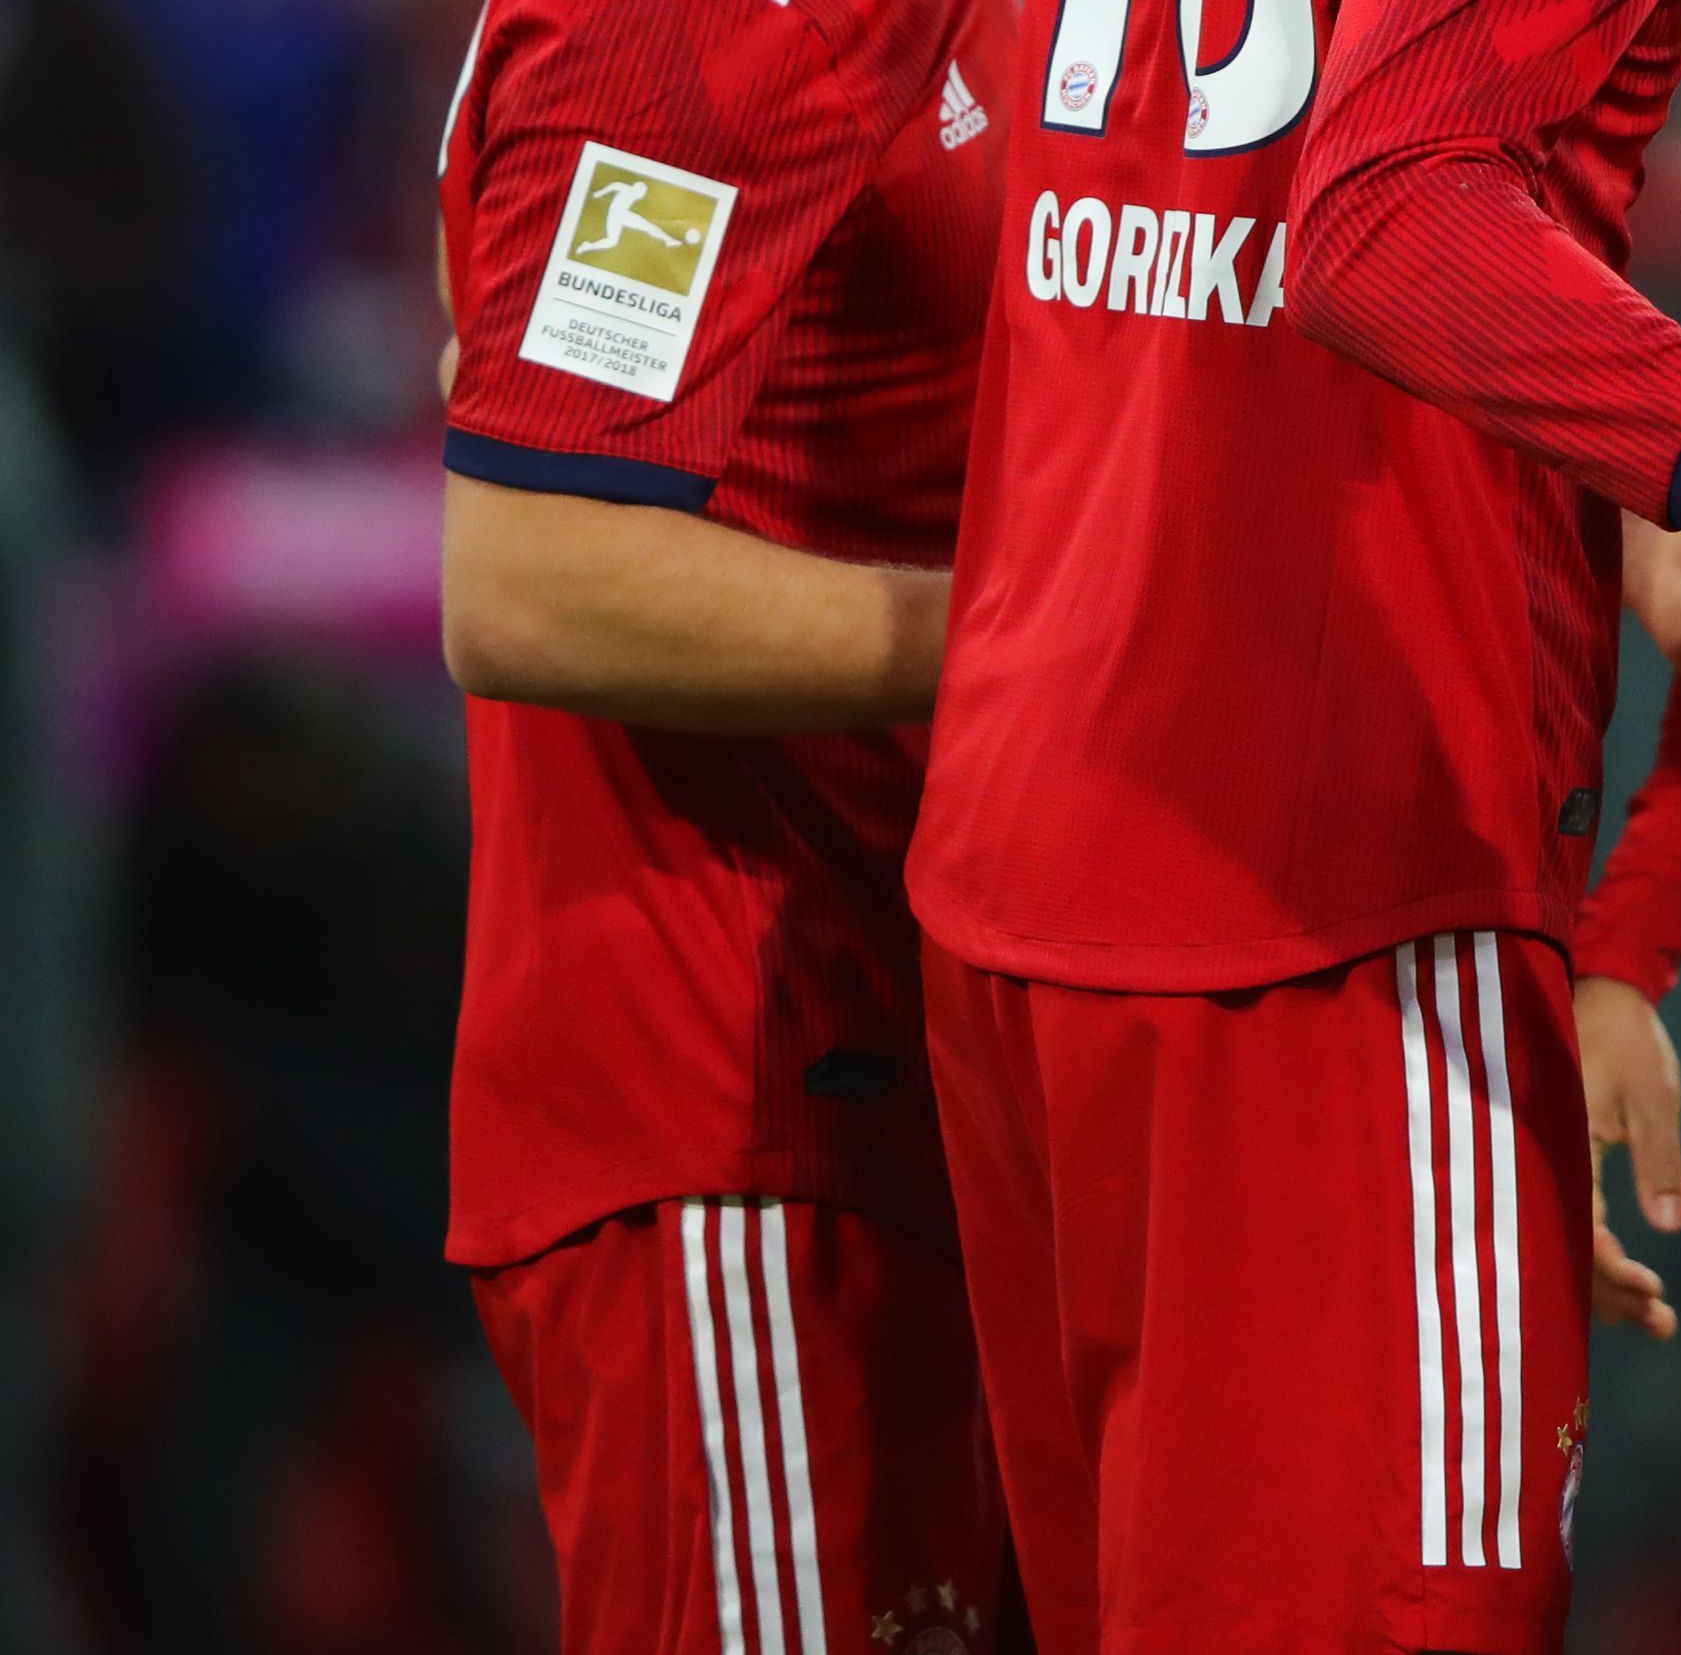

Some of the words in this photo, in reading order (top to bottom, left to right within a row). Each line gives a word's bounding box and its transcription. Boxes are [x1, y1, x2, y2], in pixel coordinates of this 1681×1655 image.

[939, 104, 989, 150] adidas
[558, 270, 683, 323] BUNDESLIGA
[541, 324, 668, 372] FUSSBALLMEISTER
[568, 318, 650, 353] DEUTSCHER
[564, 345, 638, 377] 2017/2018
